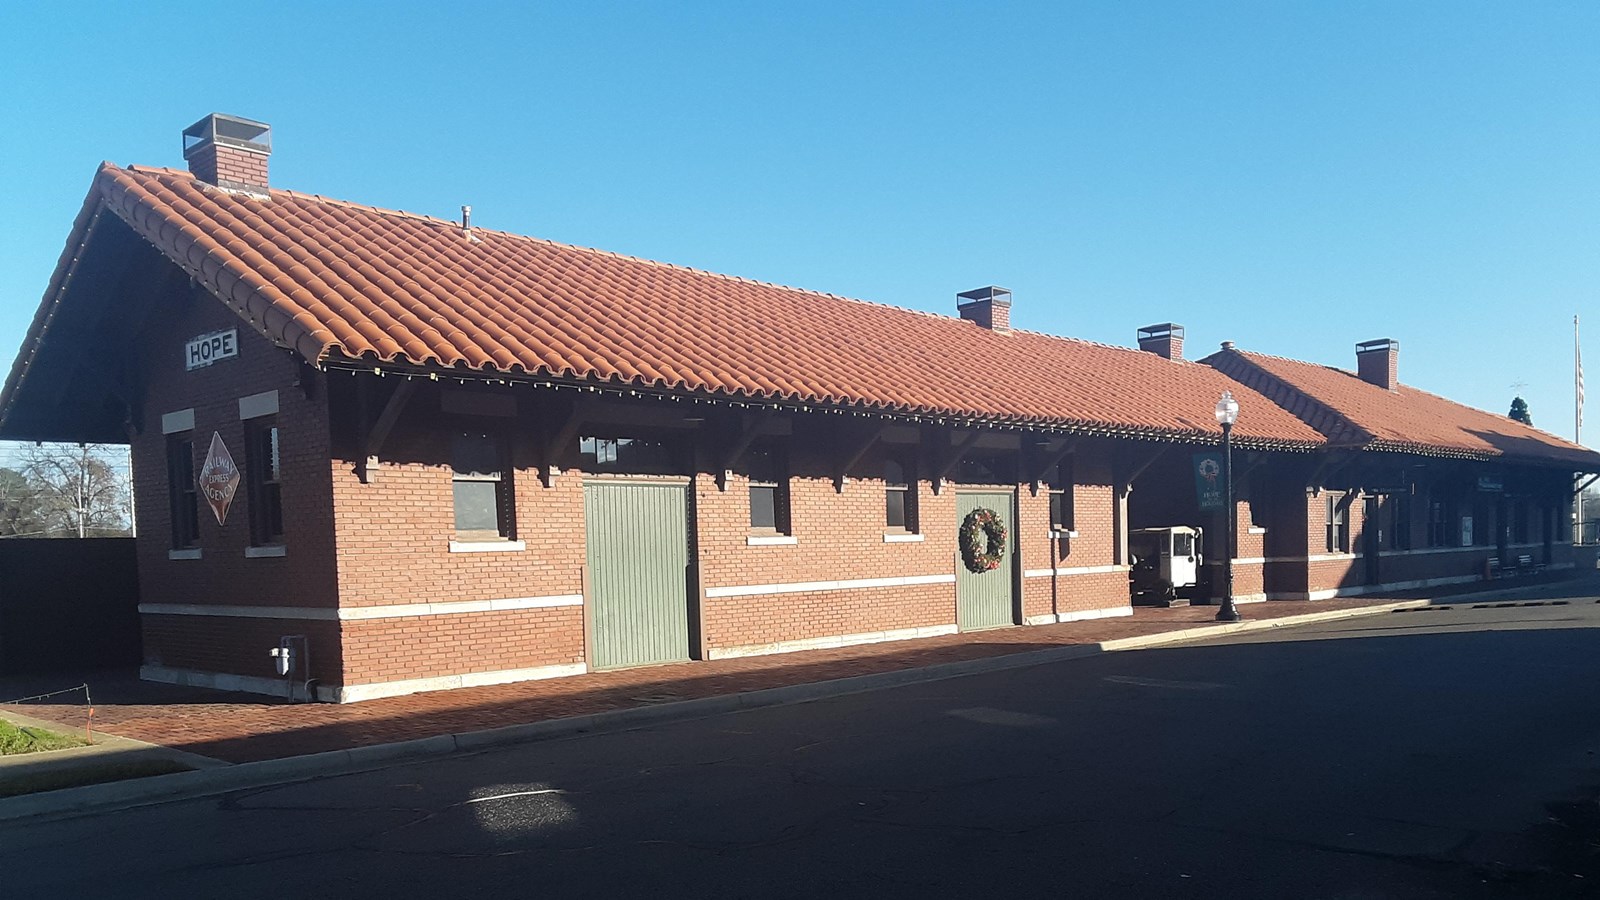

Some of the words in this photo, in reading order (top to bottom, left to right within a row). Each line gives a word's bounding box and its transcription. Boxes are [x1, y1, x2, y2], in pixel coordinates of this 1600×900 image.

[191, 334, 233, 363] HOPE
[205, 456, 234, 477] RAILWAY
[205, 484, 233, 501] AGENCY
